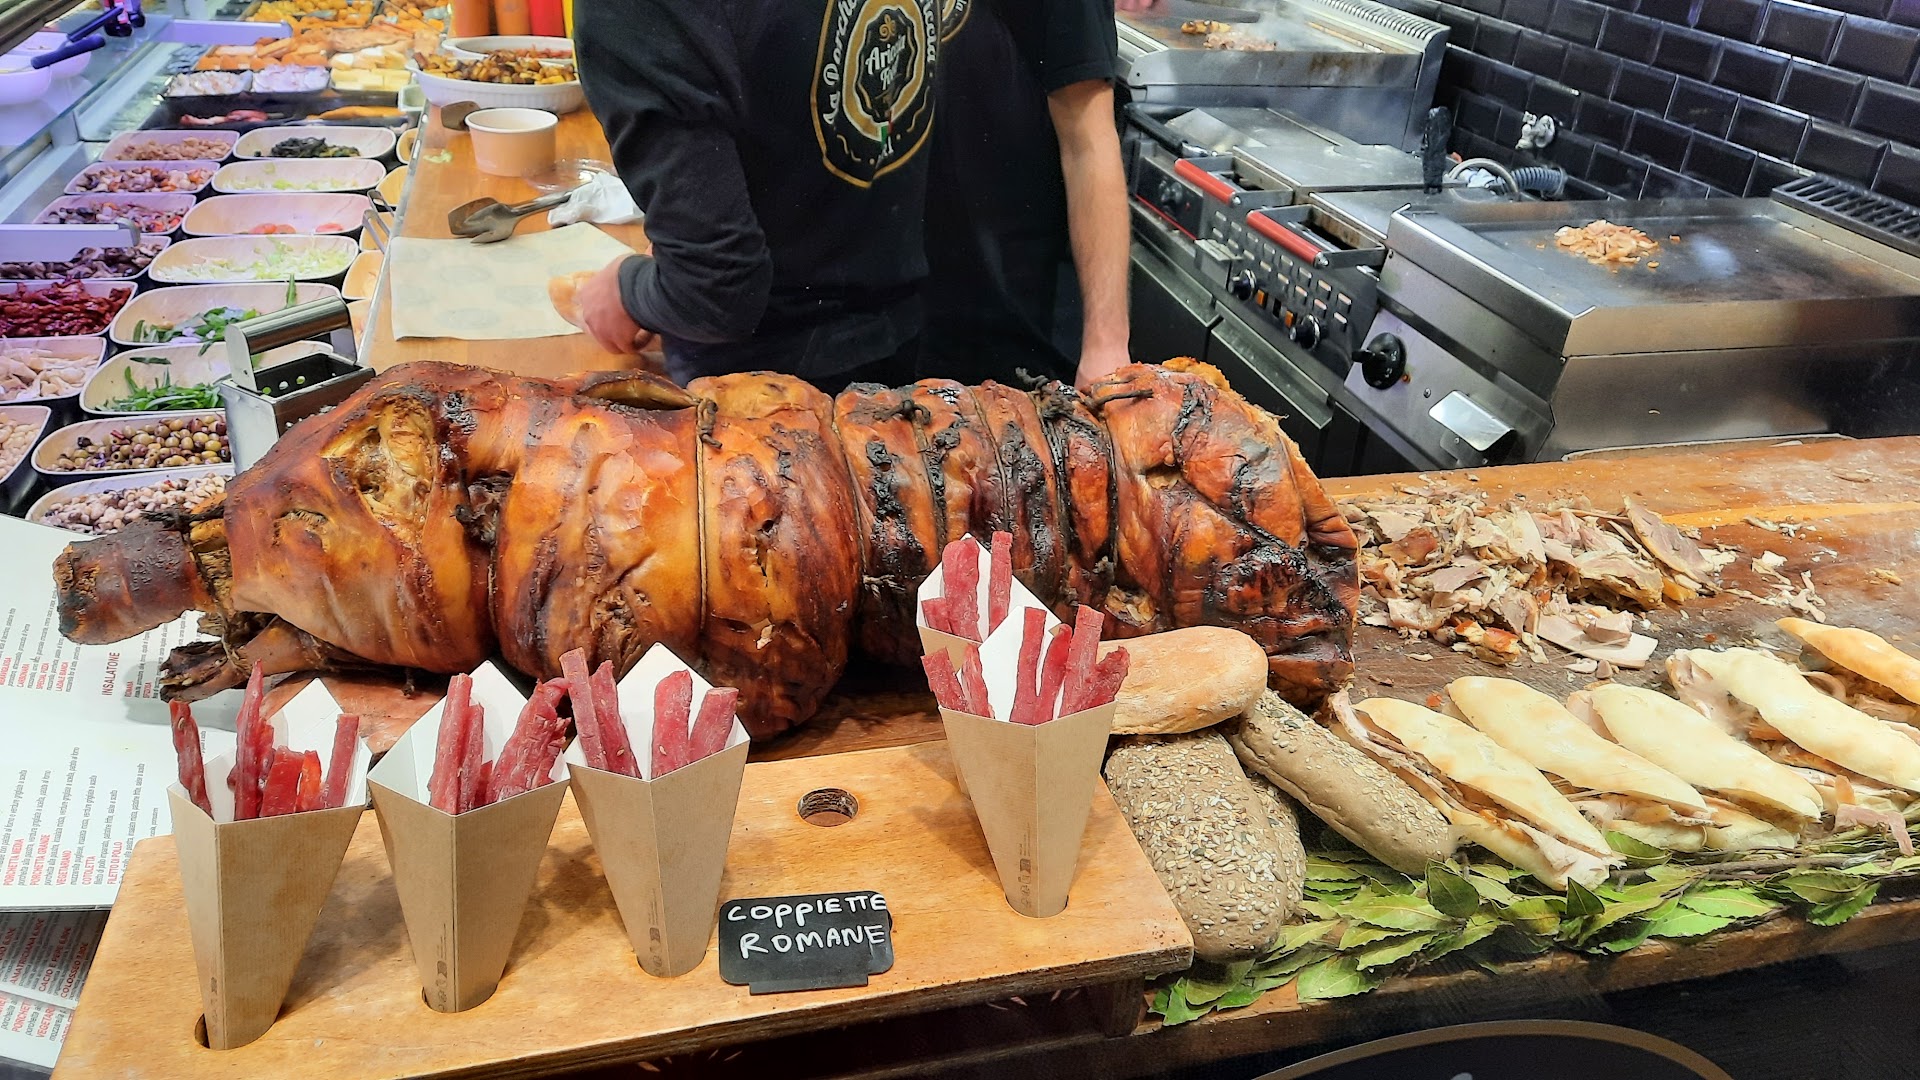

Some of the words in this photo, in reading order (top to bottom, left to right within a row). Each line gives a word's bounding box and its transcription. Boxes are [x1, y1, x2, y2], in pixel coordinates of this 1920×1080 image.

[17, 664, 30, 687] CARBONARA
[40, 663, 49, 673] PIZZA
[59, 662, 68, 675] BIANCA
[101, 652, 119, 695] INSALATONE
[36, 675, 46, 689] SPECIAL
[55, 676, 66, 691] LAZIALE
[10, 839, 24, 854] MEDIA
[30, 856, 46, 885] PORCHETTA
[38, 835, 50, 854] GRANDE
[111, 842, 122, 858] POLLO
[3, 855, 20, 885] PORCHETTA
[56, 850, 71, 885] VEGETARIANO
[82, 856, 96, 885] COTOLETTA
[107, 864, 118, 884] FILETTO
[728, 894, 887, 928] COPPIETTE
[740, 925, 885, 959] ROMANE
[9, 937, 36, 984] AMATRICIANA
[39, 969, 53, 992] CACIO
[51, 946, 65, 962] PEPE
[61, 961, 81, 998] COLOSSEO
[1, 1006, 15, 1030] porchetta
[25, 1012, 39, 1036] porchetta
[49, 1014, 65, 1041] mozzarella
